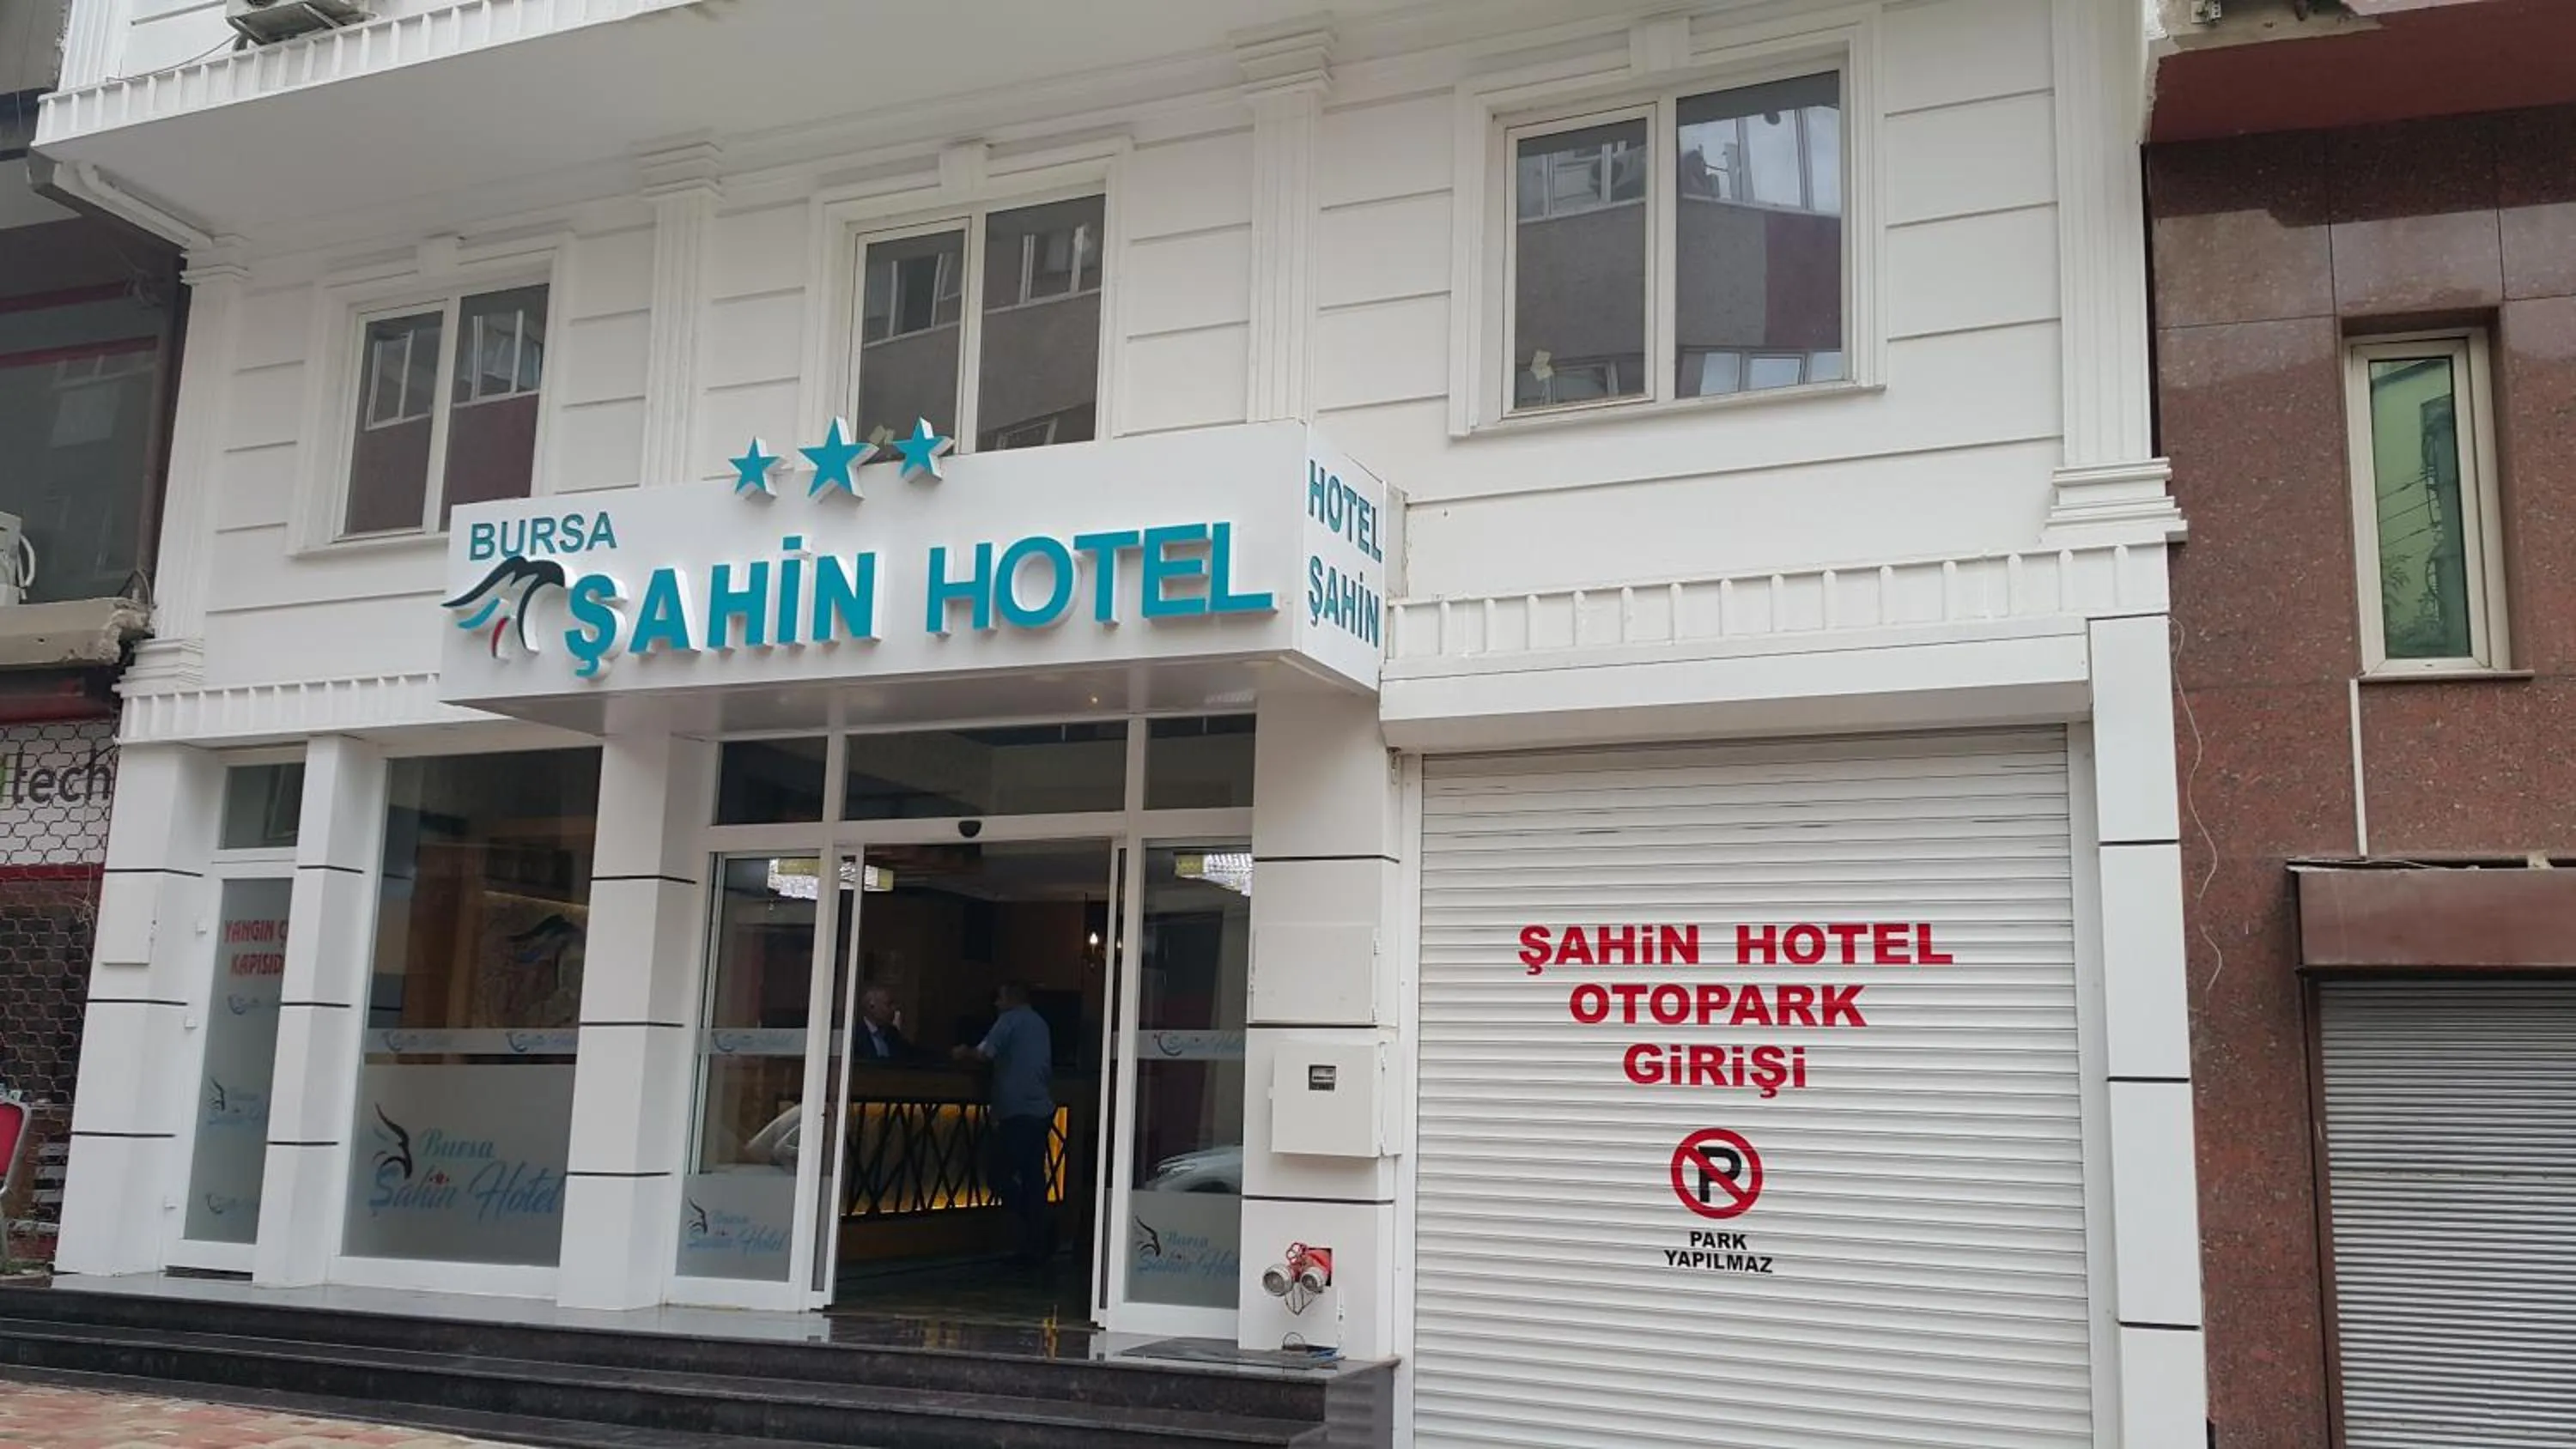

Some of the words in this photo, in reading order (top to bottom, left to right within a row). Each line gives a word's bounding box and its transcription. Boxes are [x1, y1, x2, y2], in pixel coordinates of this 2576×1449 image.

[1308, 459, 1383, 564] HOTEL
[470, 512, 617, 561] BURSA
[564, 534, 881, 678] ŞAHİN
[925, 521, 1276, 635] HOTEL
[1307, 555, 1381, 649] ŞAHİN
[224, 919, 275, 943] YANGIN
[1735, 923, 1954, 966] HOTEL
[230, 953, 285, 976] KAPISID
[1569, 983, 1868, 1028] OTOPARK
[419, 1128, 496, 1159] Bursa
[469, 1161, 568, 1224] Hotel
[1663, 1249, 1774, 1274] YAPILMAZ
[1689, 1230, 1747, 1251] PARK
